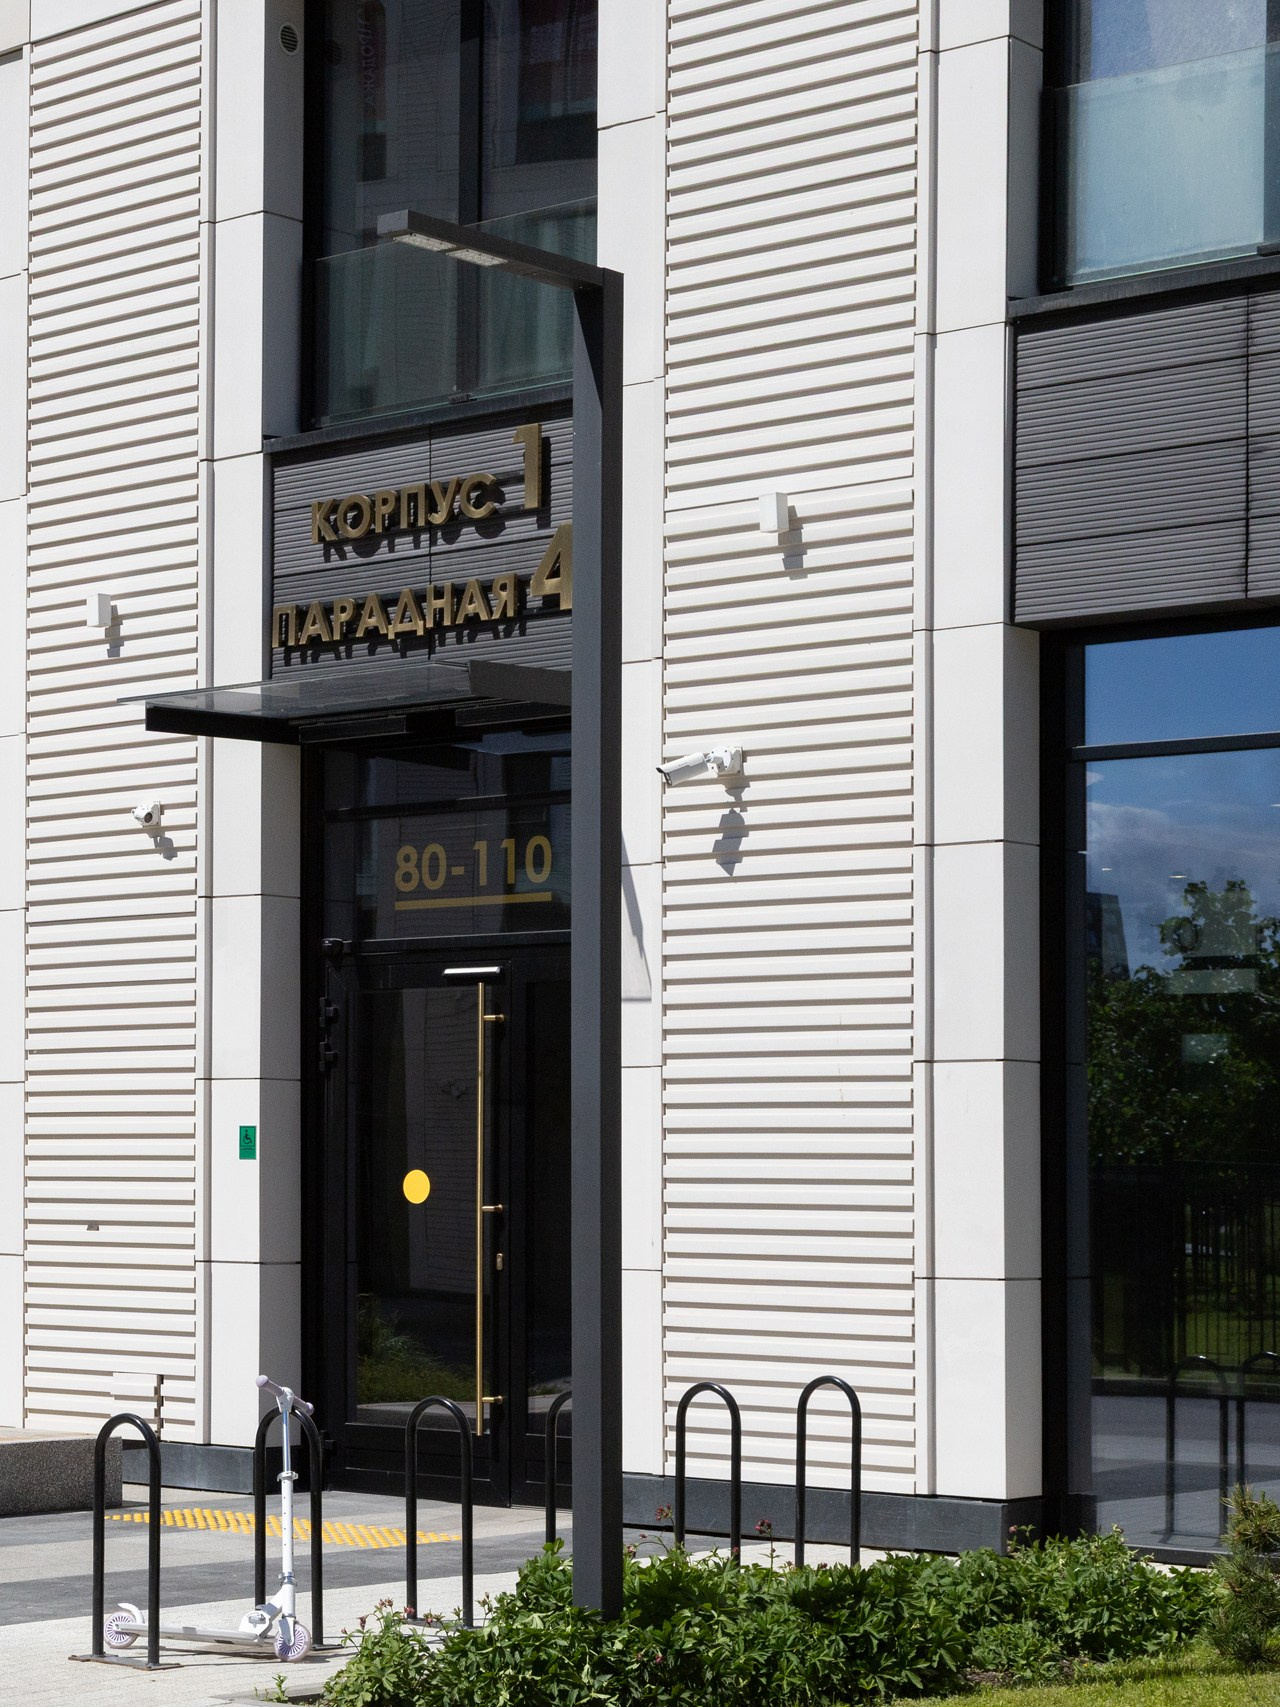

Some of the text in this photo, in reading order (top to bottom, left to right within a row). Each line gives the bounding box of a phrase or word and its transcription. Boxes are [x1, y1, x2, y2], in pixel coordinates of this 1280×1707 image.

[311, 422, 543, 545] КОРПУС 1
[272, 523, 573, 648] ПАРАДНАЯ 4
[395, 835, 552, 892] 80-110
